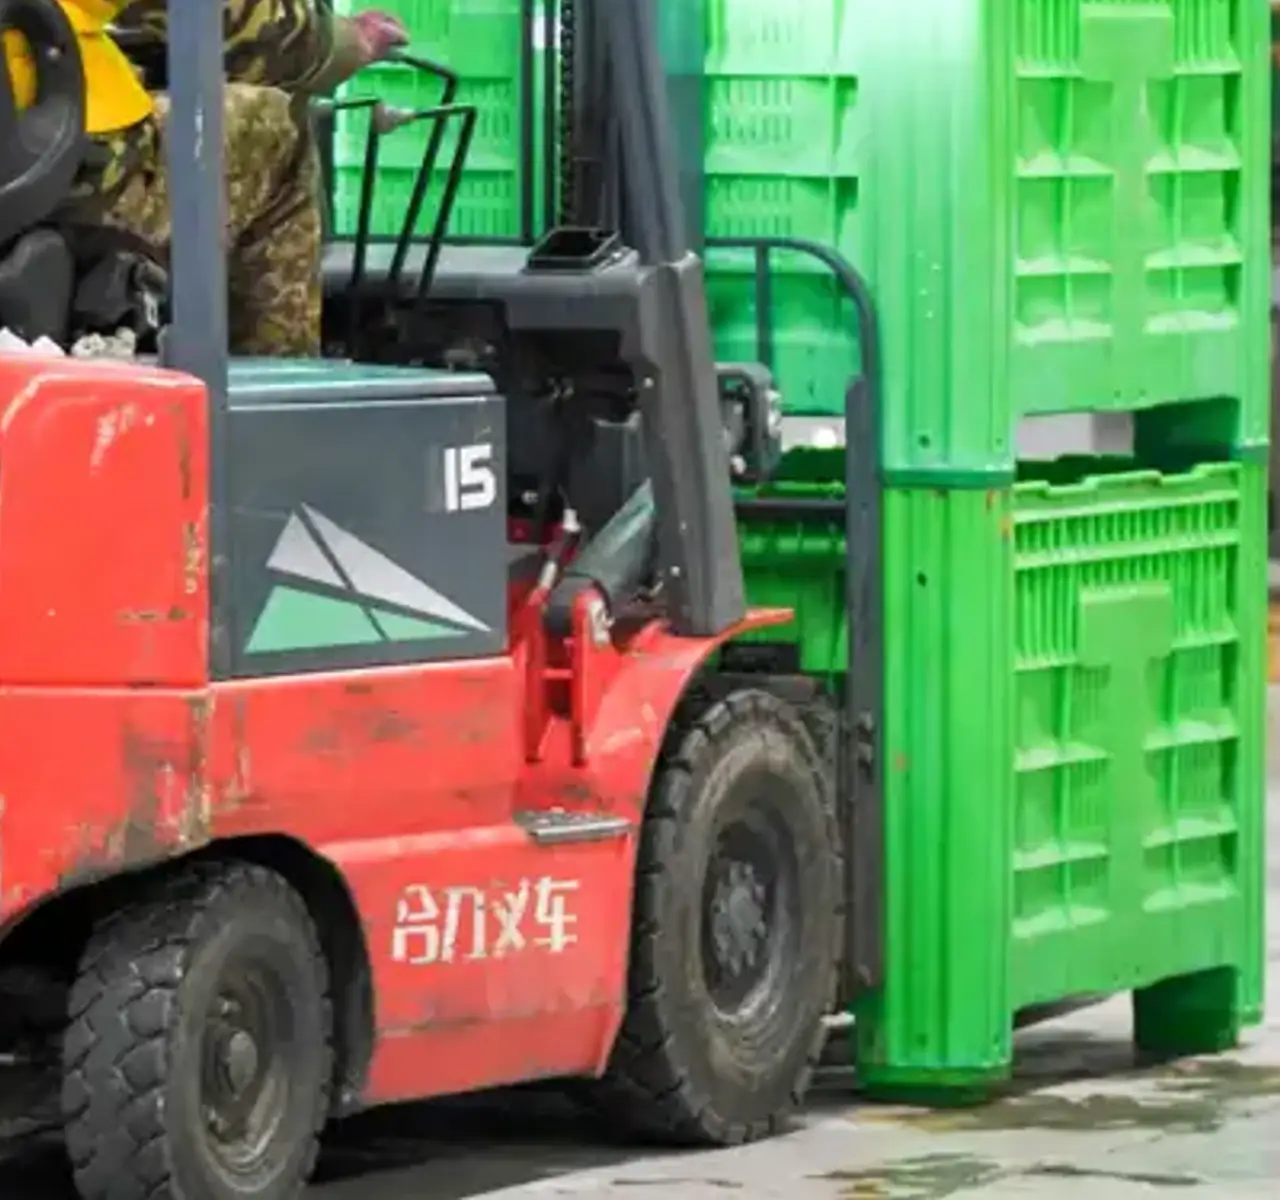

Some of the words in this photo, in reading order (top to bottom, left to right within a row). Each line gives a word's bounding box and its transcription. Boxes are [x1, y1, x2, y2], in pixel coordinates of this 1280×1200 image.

[443, 443, 497, 513] 15
[391, 875, 579, 964] 合力叉车
